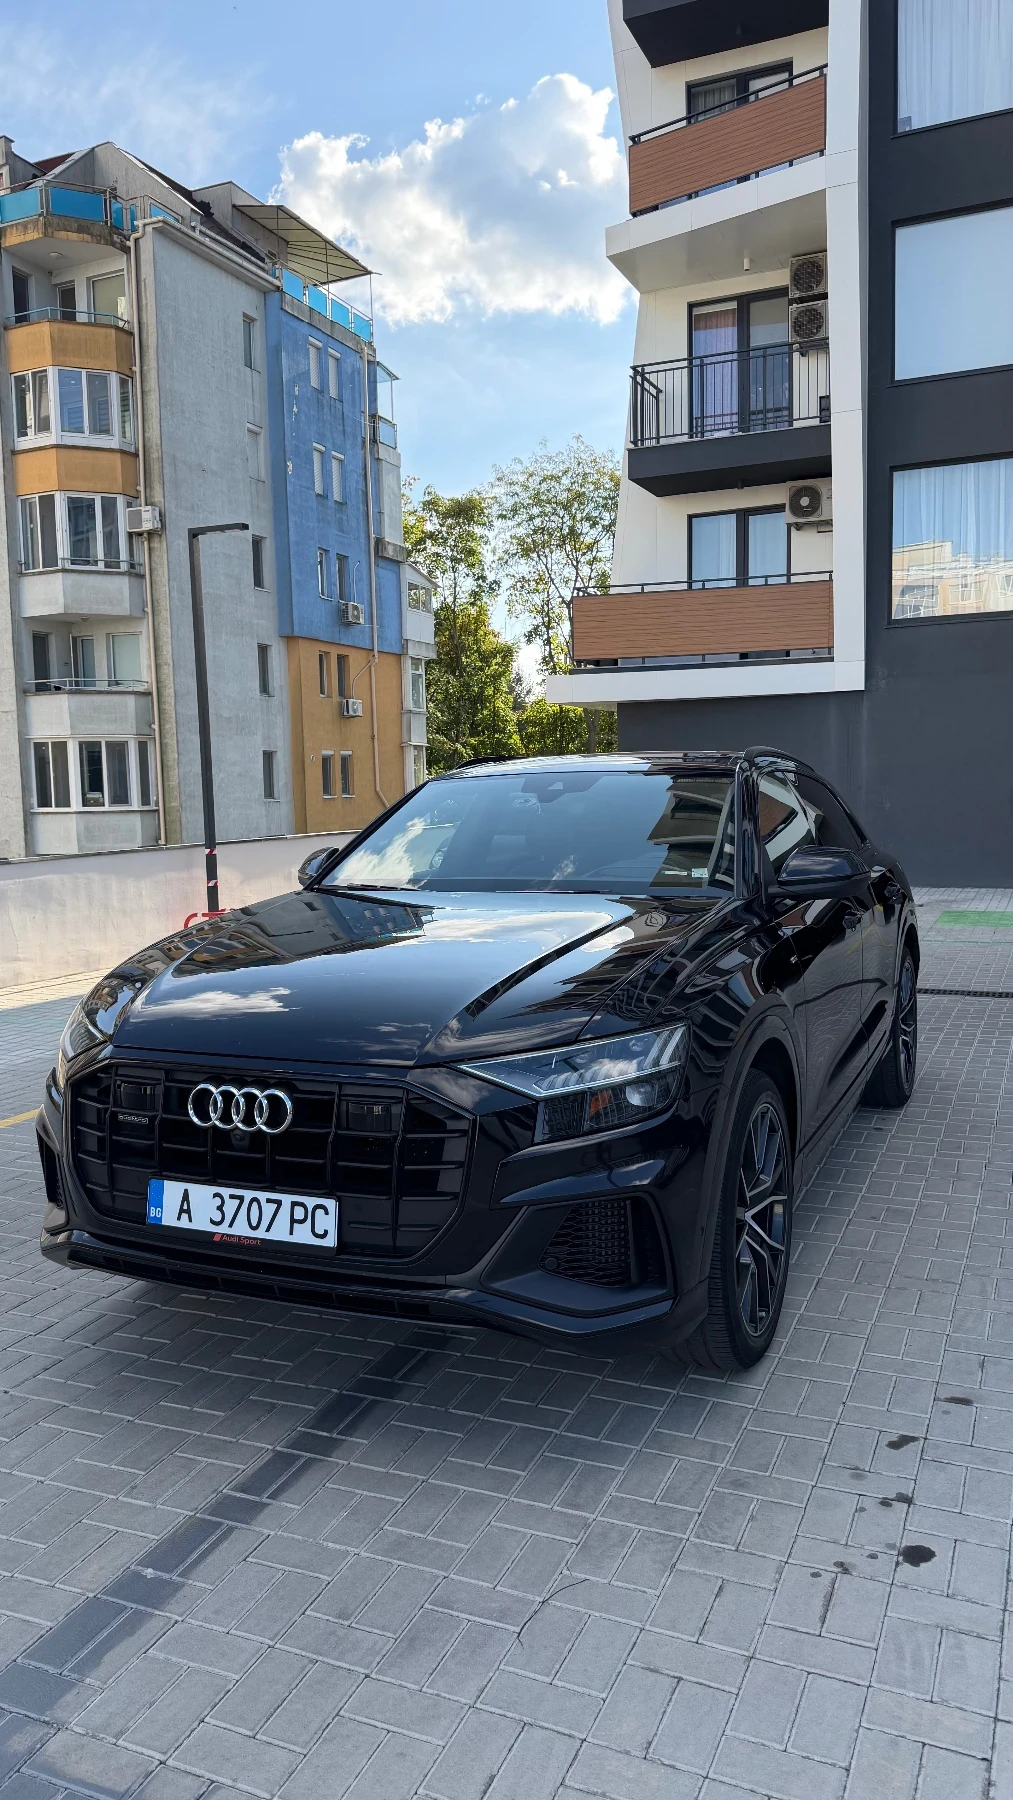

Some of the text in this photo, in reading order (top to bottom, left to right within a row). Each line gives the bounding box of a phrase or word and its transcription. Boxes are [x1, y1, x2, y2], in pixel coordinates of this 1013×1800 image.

[149, 1206, 162, 1218] BG
[176, 1188, 330, 1240] A 3707 PC
[222, 1235, 261, 1246] Audi Sport
